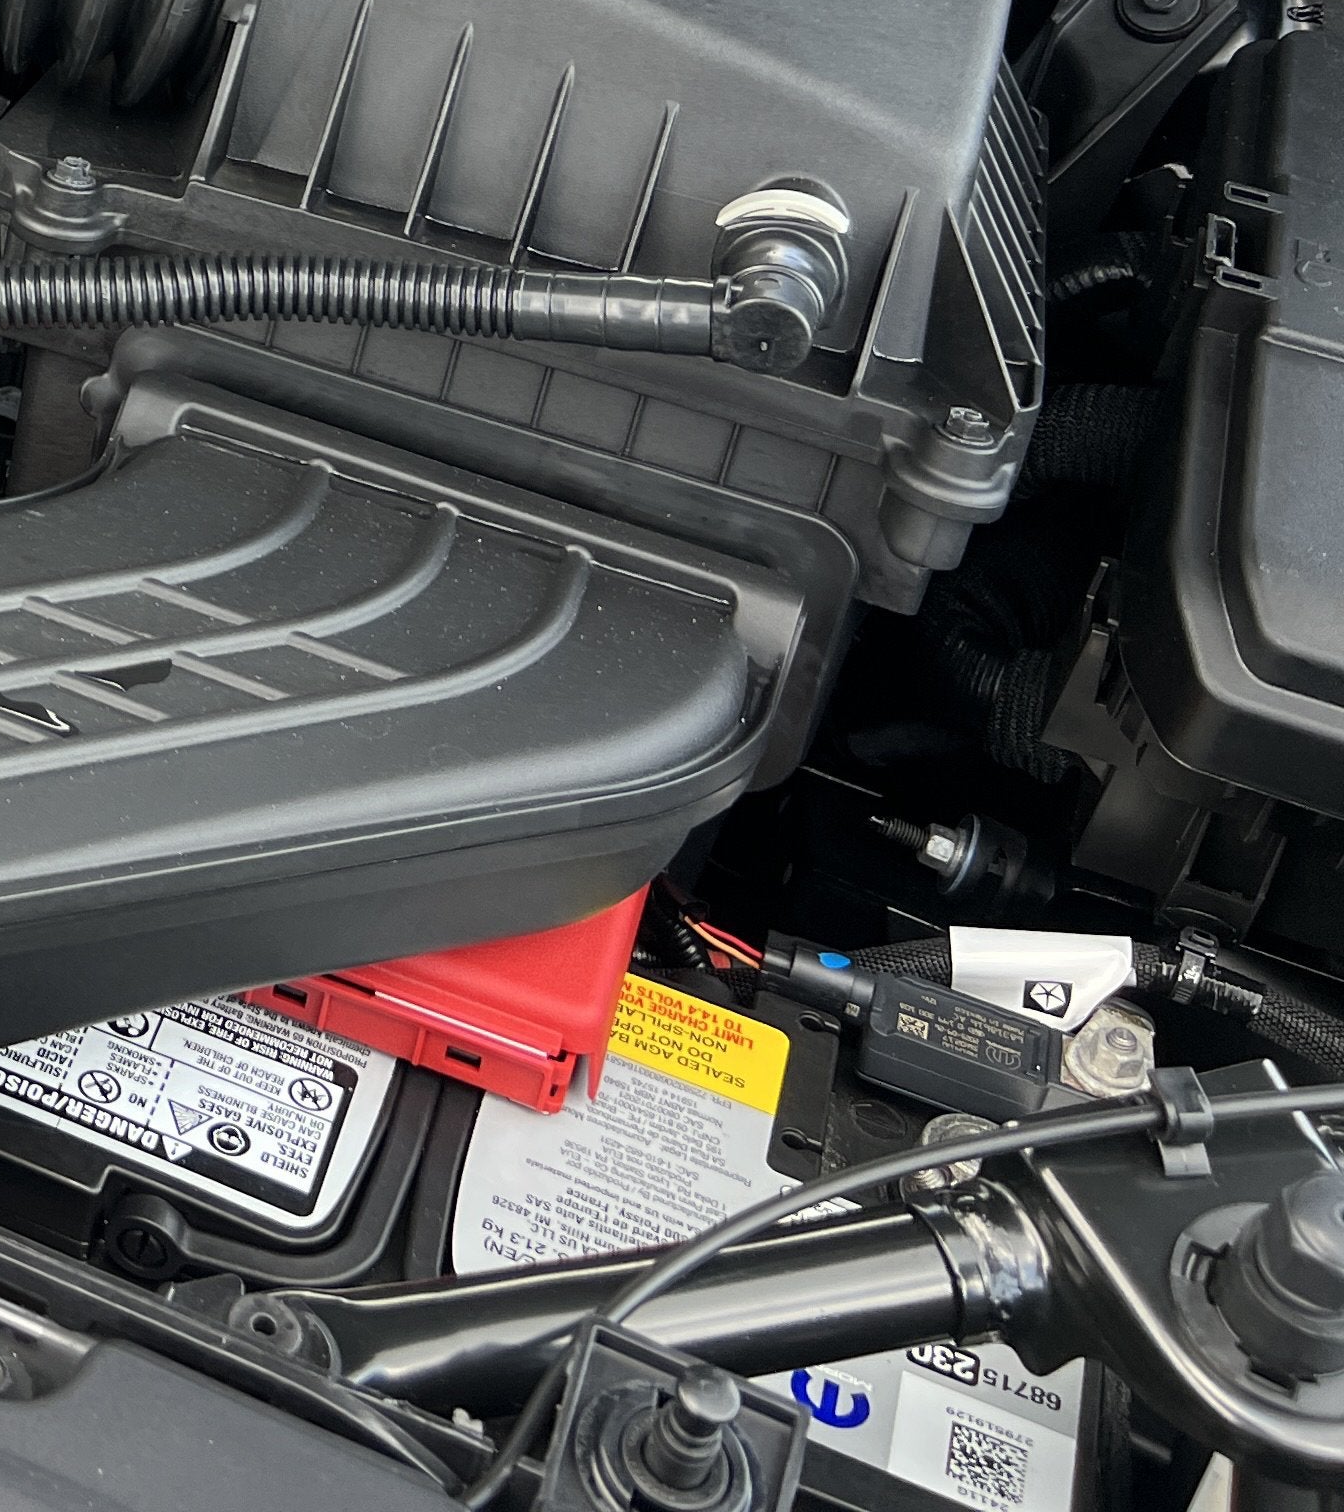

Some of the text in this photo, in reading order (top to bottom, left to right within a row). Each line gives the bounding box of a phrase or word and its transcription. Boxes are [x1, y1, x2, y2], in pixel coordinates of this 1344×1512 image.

[210, 997, 244, 1018] Battery
[635, 983, 684, 1012] VOLTS
[200, 1009, 224, 1025] FOR
[261, 1008, 278, 1021] the
[647, 999, 709, 1033] CHARGE
[687, 1004, 718, 1024] 14.4
[289, 1019, 322, 1038] known
[723, 1017, 744, 1033] TO
[49, 1038, 72, 1053] CAN
[223, 1018, 309, 1059] RECOMMENDED
[232, 1034, 248, 1047] OF
[646, 1029, 683, 1051] NOT
[711, 1024, 754, 1050] LIMIT
[35, 1045, 67, 1066] ACID
[250, 1040, 278, 1058] RISK
[305, 1036, 367, 1068] PROPOSITION
[308, 1051, 334, 1068] NOT
[609, 1028, 746, 1089] SEALED AGM BA
[686, 1045, 713, 1063] DO
[180, 1038, 285, 1086] REACH OF CHILDREN.
[277, 1051, 334, 1080] WARNING:
[196, 1055, 281, 1095] KEEP OUT OF THE
[127, 1092, 147, 1107] NO
[196, 1084, 322, 1140] CAN CAUSE BLINDNESS
[196, 1097, 318, 1152] EXPLOSIVE GASES
[308, 1118, 325, 1130] OR
[258, 1150, 309, 1178] SHIELD
[274, 1142, 313, 1165] EYES.
[491, 1194, 531, 1217] 48326
[524, 1192, 552, 1210] SAS
[565, 1186, 609, 1211] France
[534, 1211, 551, 1225] MI
[554, 1205, 583, 1224] Auto
[612, 1217, 627, 1230] de
[480, 1216, 504, 1238] kg
[509, 1231, 546, 1254] 21.3
[558, 1234, 577, 1249] US
[981, 1366, 1061, 1412] 68715
